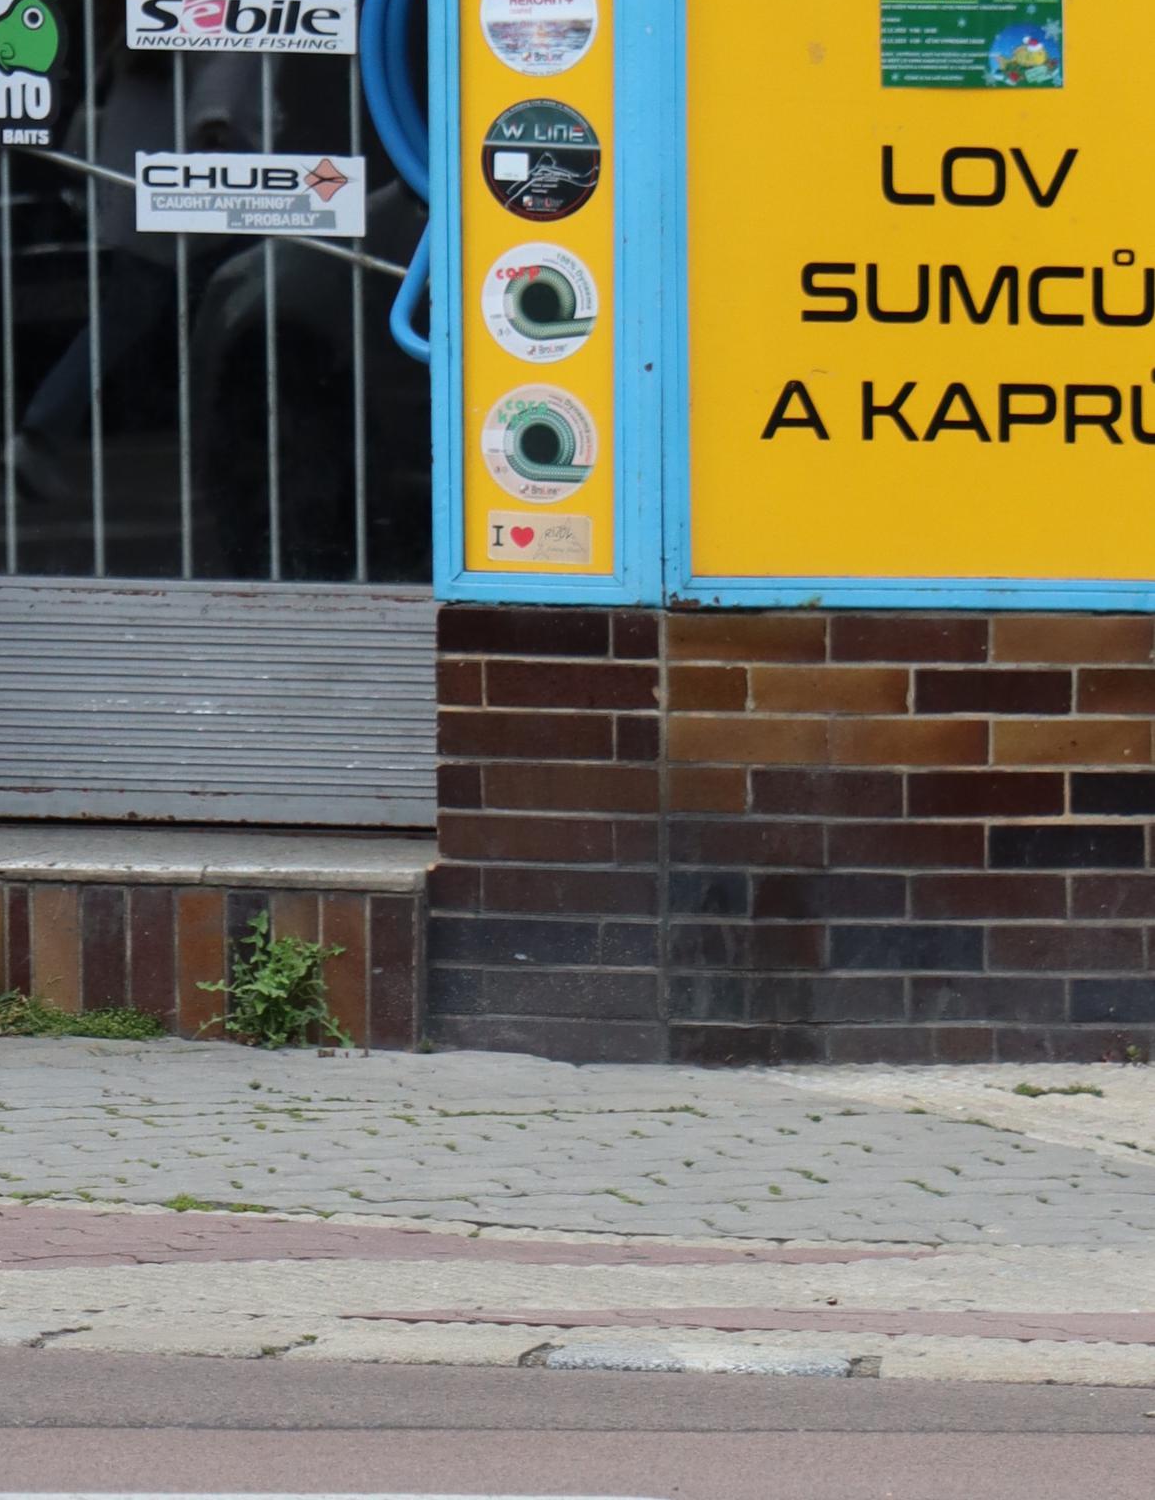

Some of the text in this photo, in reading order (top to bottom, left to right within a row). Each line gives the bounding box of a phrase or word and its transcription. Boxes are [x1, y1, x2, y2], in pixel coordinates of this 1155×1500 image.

[135, 35, 338, 51] INNOVATIVE FISHING
[2, 128, 49, 145] BAITS
[501, 122, 525, 139] W
[141, 164, 299, 190] CHUB
[881, 145, 1080, 209] LOV
[495, 265, 540, 282] carp
[800, 248, 1155, 327] SUMCŮ
[760, 380, 831, 441] A
[492, 524, 504, 547] I
